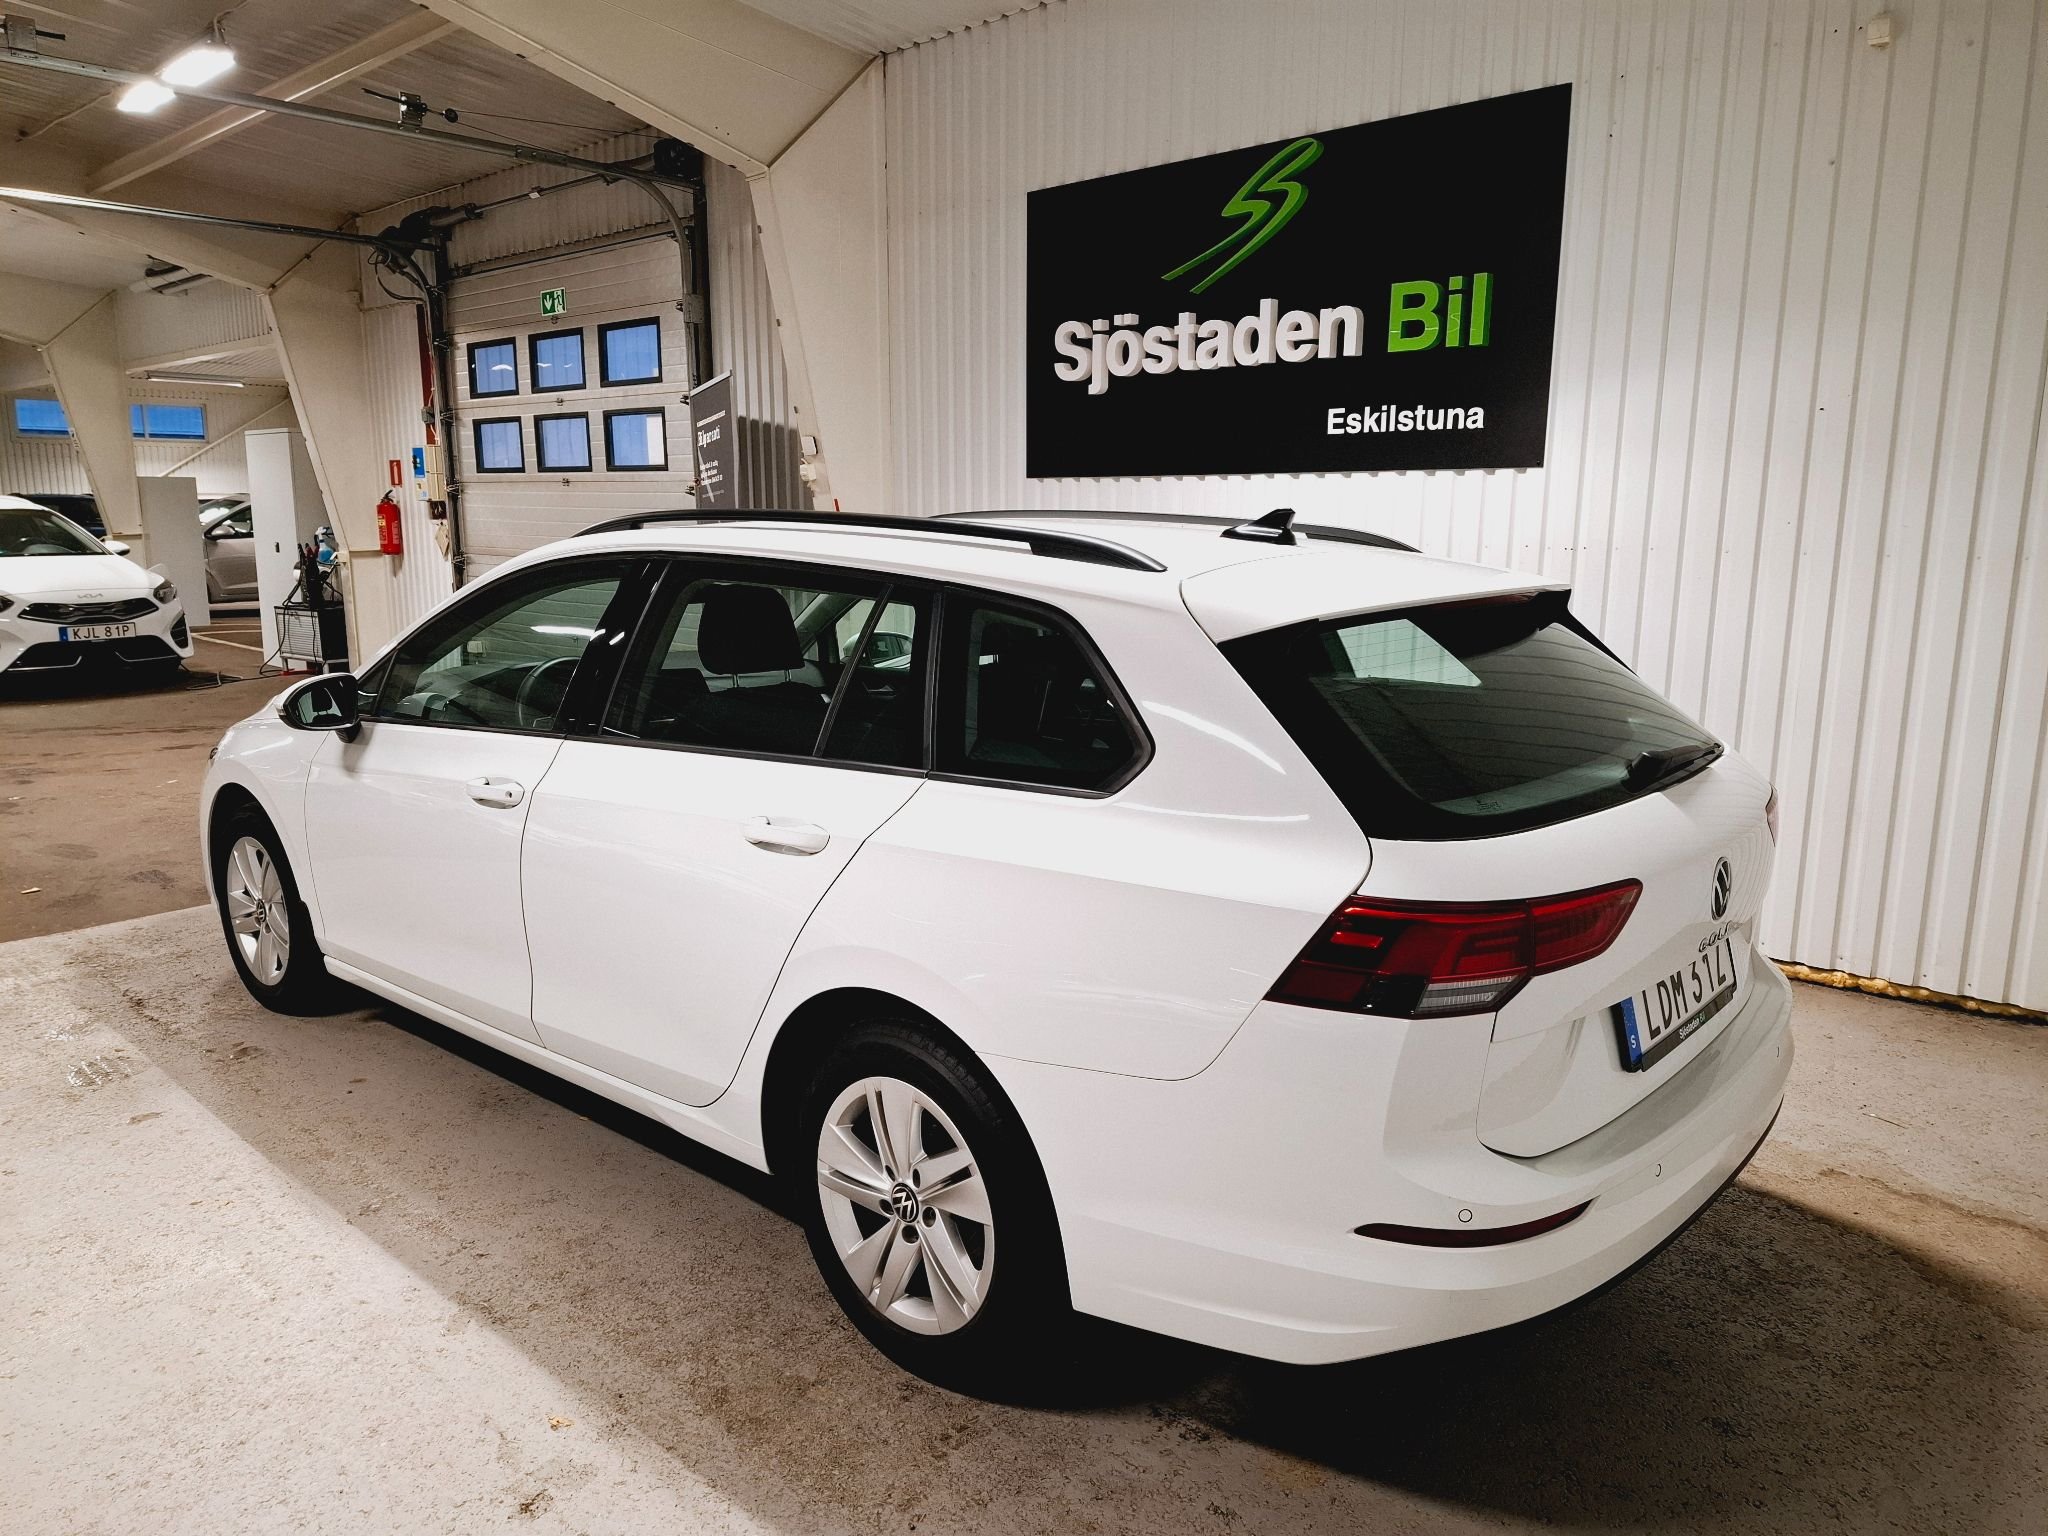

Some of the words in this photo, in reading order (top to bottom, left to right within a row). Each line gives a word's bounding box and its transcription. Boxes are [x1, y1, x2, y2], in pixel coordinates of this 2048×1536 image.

[1054, 298, 1363, 395] Sjöstaden
[1387, 272, 1494, 353] Bil
[1326, 403, 1485, 436] Eskilstuna
[72, 627, 100, 640] KJL
[104, 625, 130, 637] 81P
[1641, 970, 1689, 1041] LDM
